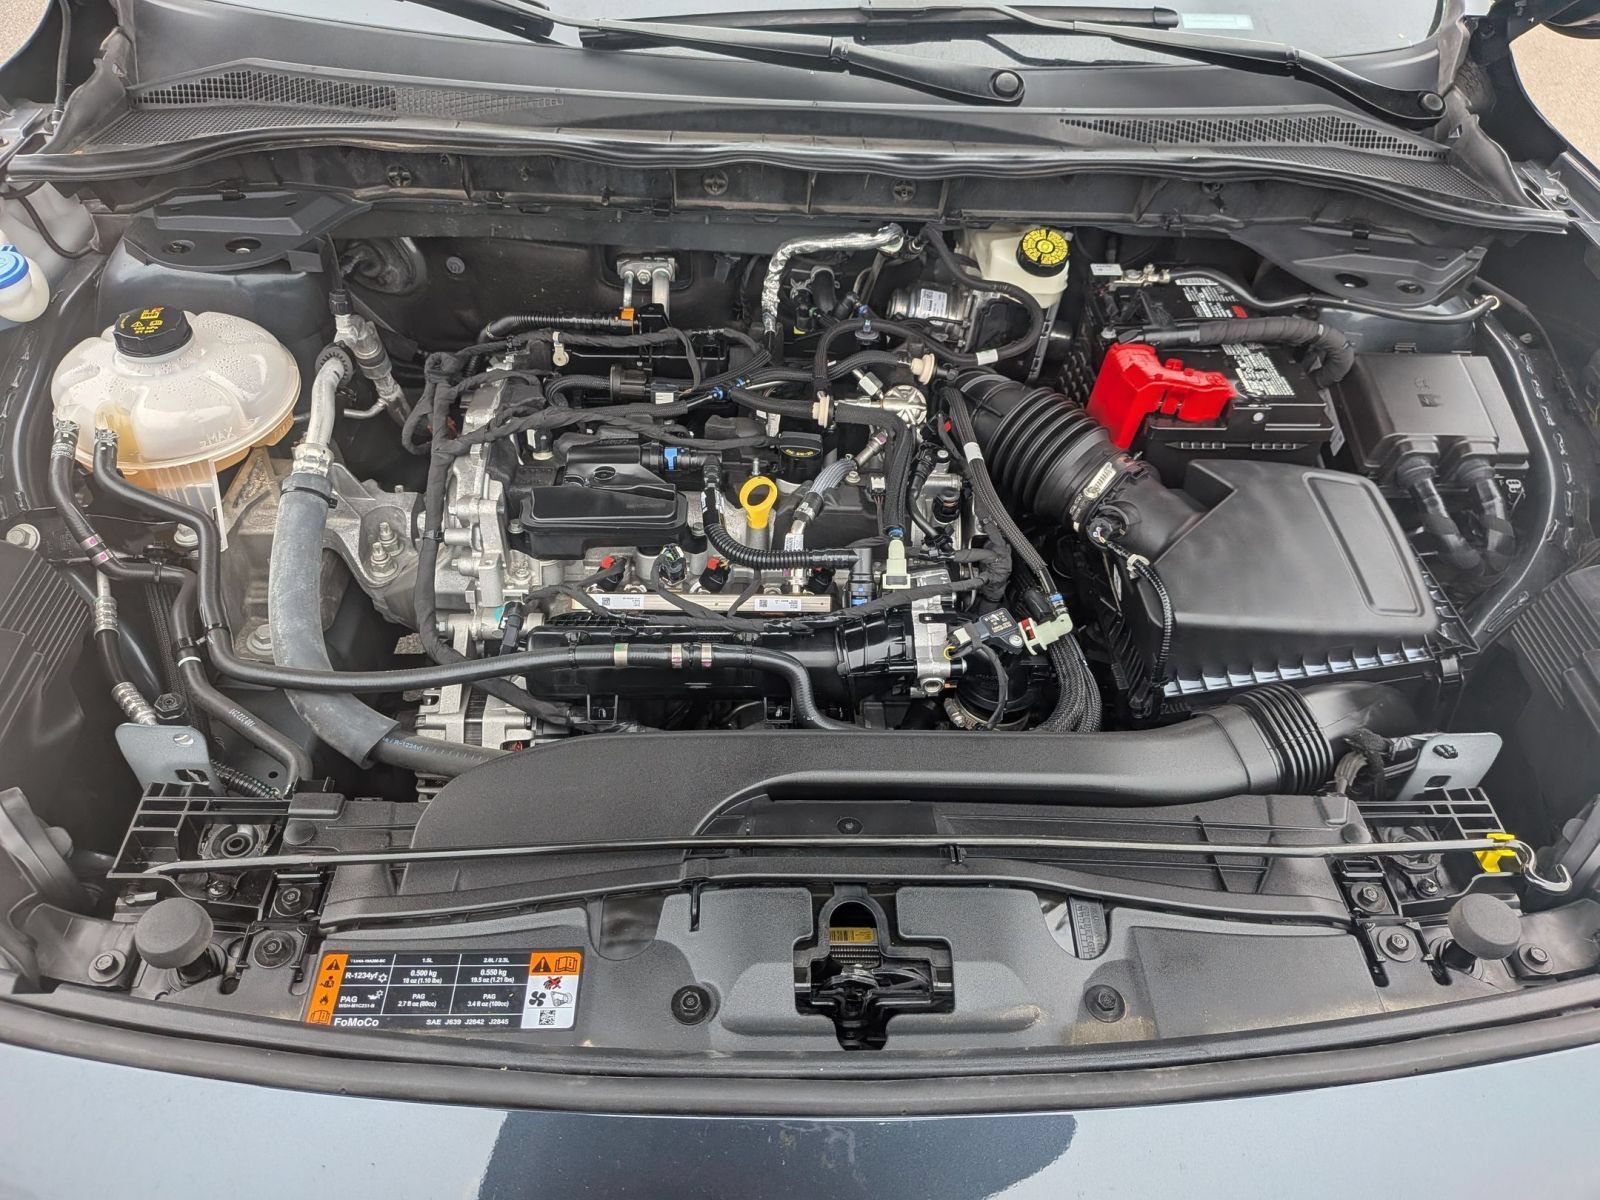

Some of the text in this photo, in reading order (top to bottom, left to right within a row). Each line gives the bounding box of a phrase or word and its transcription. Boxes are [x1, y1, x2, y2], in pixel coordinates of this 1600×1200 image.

[345, 972, 378, 980] R-1234yf
[498, 969, 507, 977] kg
[334, 1018, 379, 1026] FoMoCo
